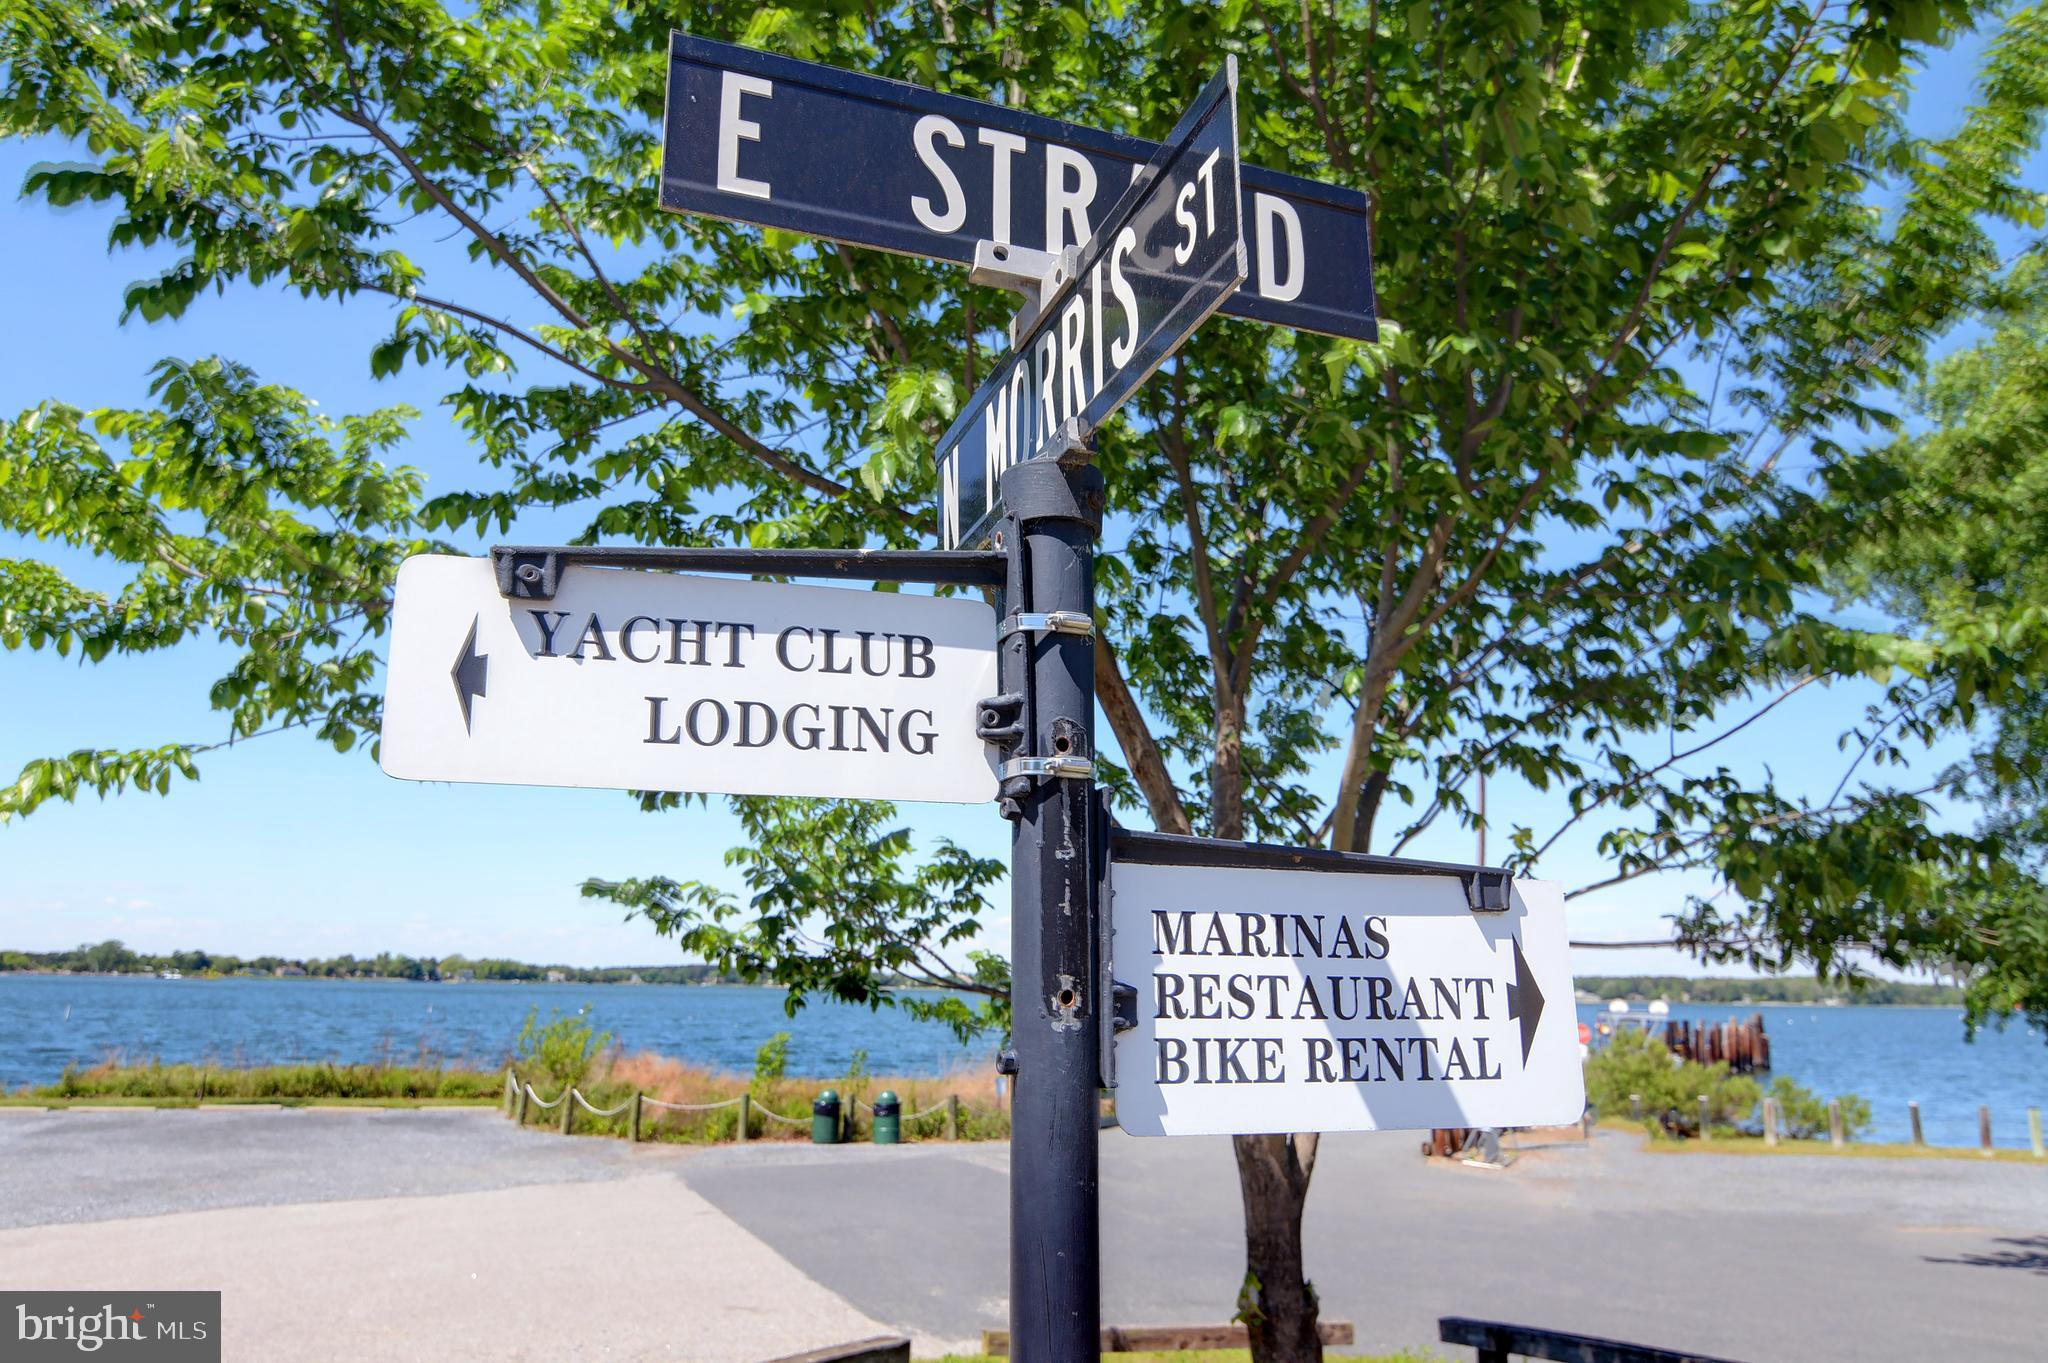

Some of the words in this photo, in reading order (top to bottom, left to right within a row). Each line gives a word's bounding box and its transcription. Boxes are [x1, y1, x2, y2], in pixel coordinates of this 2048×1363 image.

[717, 71, 772, 199] E
[911, 114, 1306, 303] STRD
[943, 445, 960, 551] N
[985, 226, 1139, 515] MORRIS
[1174, 147, 1221, 267] ST
[526, 609, 755, 668] YACHT
[775, 624, 937, 680] CLUB
[642, 695, 939, 756] LODGING
[1151, 909, 1391, 960] MARINAS
[1152, 972, 1495, 1021] RESTAURANT
[1153, 1037, 1286, 1085] BIKE
[1303, 1036, 1503, 1084] RENTAL
